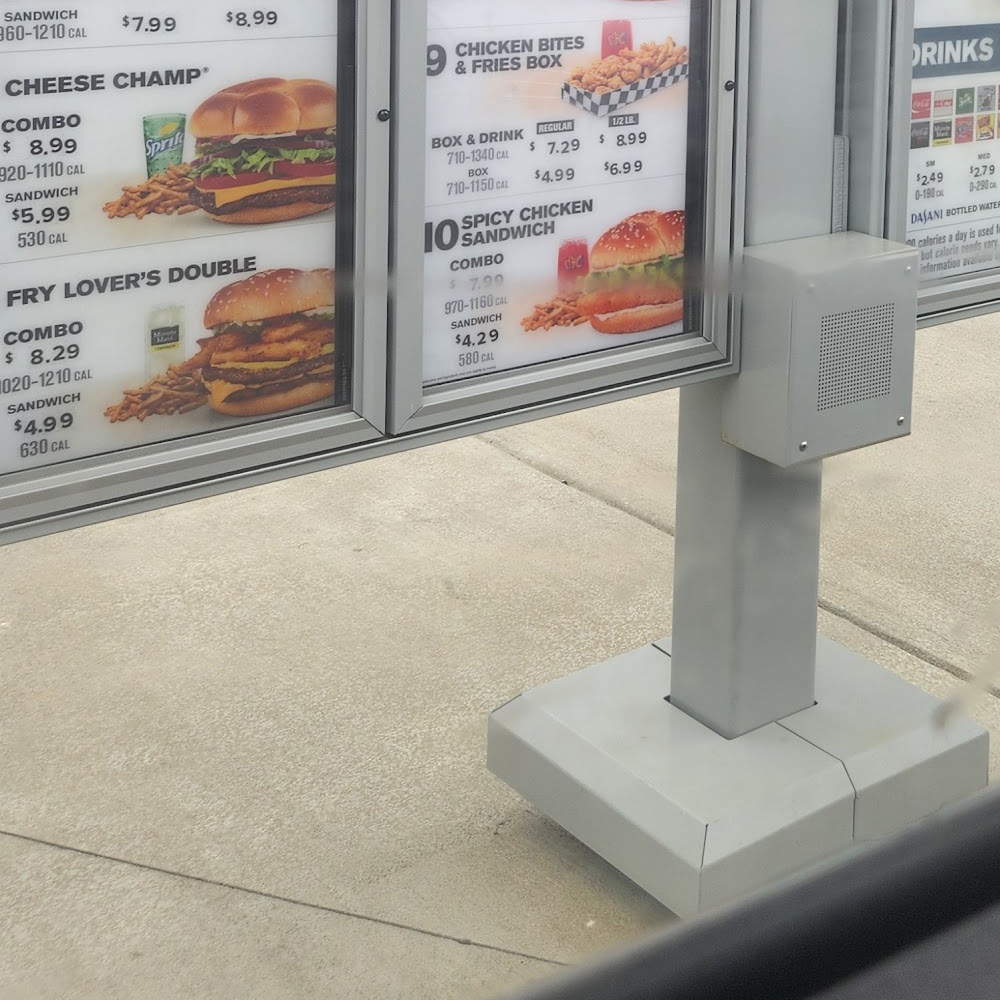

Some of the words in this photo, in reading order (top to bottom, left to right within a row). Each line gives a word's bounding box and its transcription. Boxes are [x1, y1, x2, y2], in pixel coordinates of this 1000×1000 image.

[4, 10, 78, 22] SANDWICH
[122, 15, 176, 32] $7.99
[226, 10, 278, 27] $8.99
[455, 39, 533, 58] CHICKEN
[538, 36, 584, 53] BITES
[455, 61, 466, 74] &
[472, 57, 521, 74] FRIES
[526, 54, 563, 69] BOX
[5, 74, 105, 96] CHEESE
[1, 114, 81, 133] COMBO
[539, 121, 573, 133] REGULAR
[432, 135, 462, 149] BOX
[466, 134, 476, 145] &
[479, 129, 524, 144] DRINK
[468, 167, 489, 177] BOX
[535, 168, 575, 183] $4.99
[604, 160, 643, 176] $6.99
[970, 165, 995, 178] $2.79
[916, 172, 943, 186] $2.49
[5, 186, 79, 202] SANDWICH
[11, 206, 71, 225] $5.99
[461, 210, 514, 230] SPICY
[519, 199, 593, 222] CHICKEN
[911, 209, 943, 224] DASANI
[946, 204, 977, 217] BOTTLED
[17, 230, 45, 248] 530
[48, 232, 68, 244] CAL
[461, 221, 555, 247] SANDWICH
[918, 233, 947, 248] calories
[955, 229, 967, 243] day
[977, 224, 994, 237] used
[450, 253, 504, 272] COMBO
[6, 284, 56, 307] FRY
[64, 269, 161, 298] LOVER'S
[168, 256, 257, 283] DOUBLE
[451, 313, 502, 330] SANDWICH
[3, 321, 83, 345] COMBO
[455, 329, 499, 347] $4.29
[458, 351, 479, 367] 580
[7, 392, 81, 414] SANDWICH
[14, 412, 73, 435] $4.99
[20, 440, 47, 458] 630
[51, 440, 70, 452] CAL
